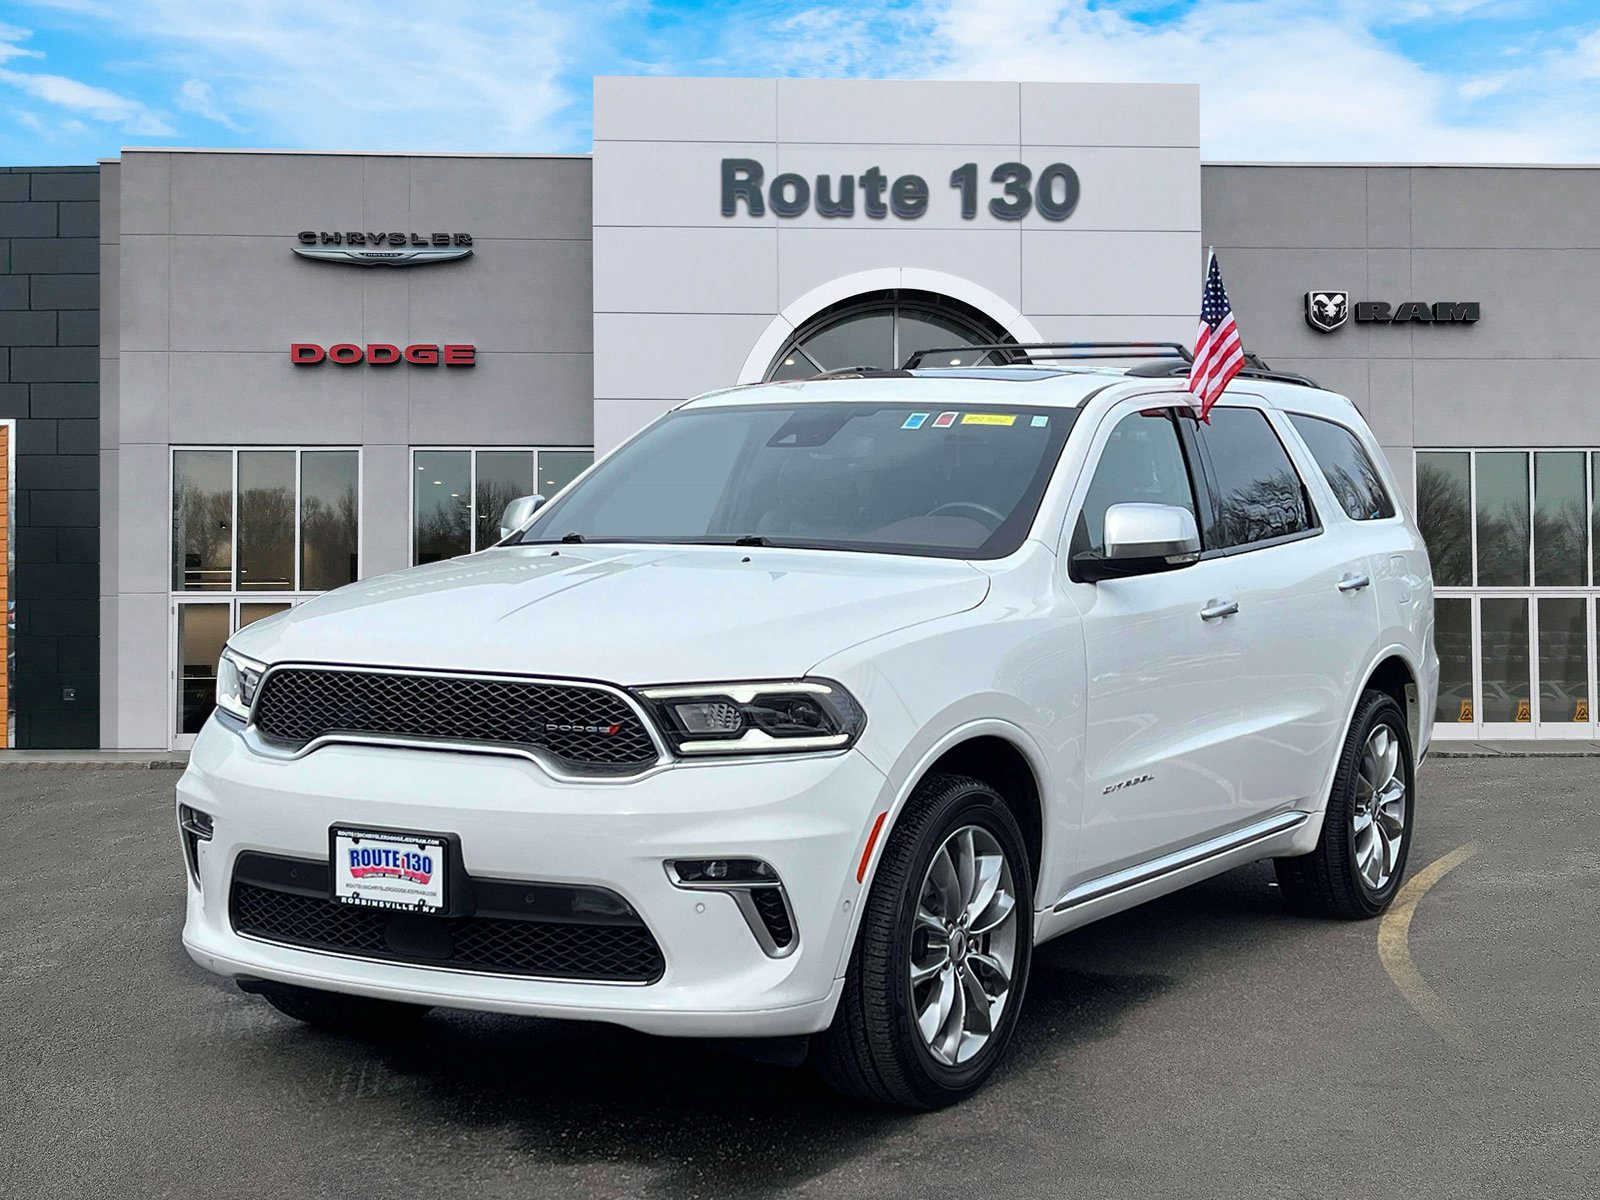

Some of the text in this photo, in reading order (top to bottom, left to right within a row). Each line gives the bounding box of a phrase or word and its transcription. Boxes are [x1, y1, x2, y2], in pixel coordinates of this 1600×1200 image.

[721, 158, 1080, 221] Route 130
[298, 231, 472, 246] CHRYSLER
[1354, 301, 1480, 324] RAM
[291, 343, 476, 366] DODGE
[545, 724, 611, 733] DODGE
[1102, 774, 1155, 795] CITADEL
[349, 848, 433, 875] ROUTE 130
[422, 904, 437, 914] NJ
